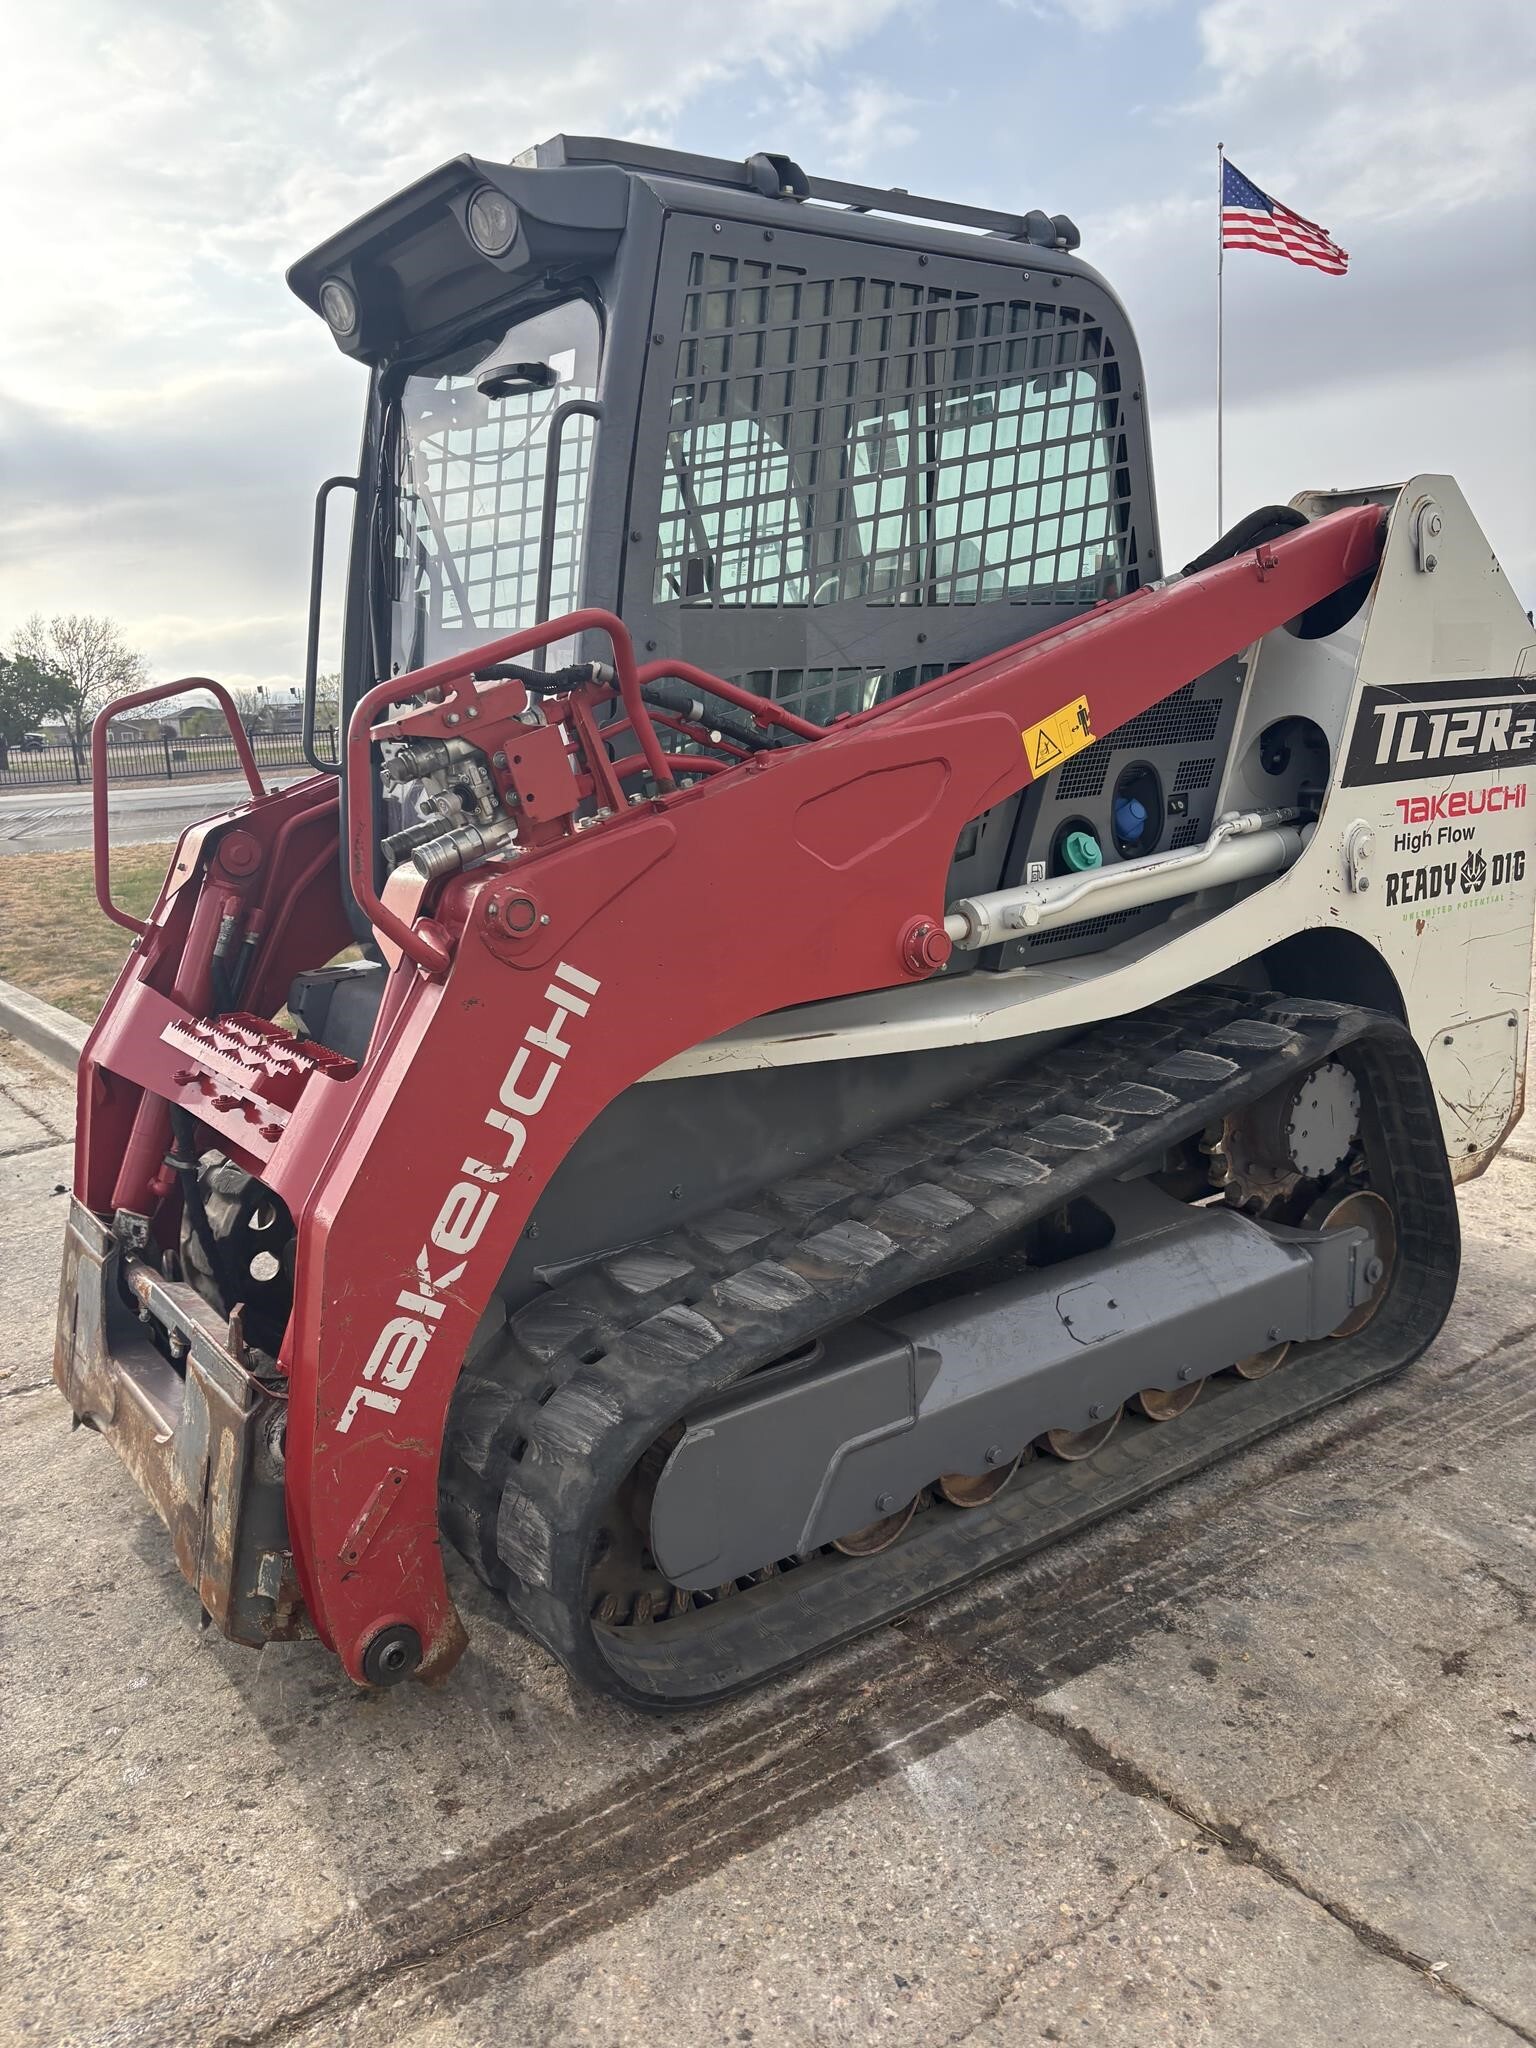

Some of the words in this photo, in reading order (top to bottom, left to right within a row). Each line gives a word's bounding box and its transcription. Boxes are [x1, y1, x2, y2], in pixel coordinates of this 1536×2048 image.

[1373, 702, 1536, 765] TL12R2
[1394, 830, 1432, 854] High
[1437, 826, 1475, 845] Flow
[1386, 862, 1457, 907] READY
[1491, 850, 1526, 886] DIG
[1402, 904, 1453, 922] UNLIMITED
[1457, 895, 1504, 911] POTENTIAL
